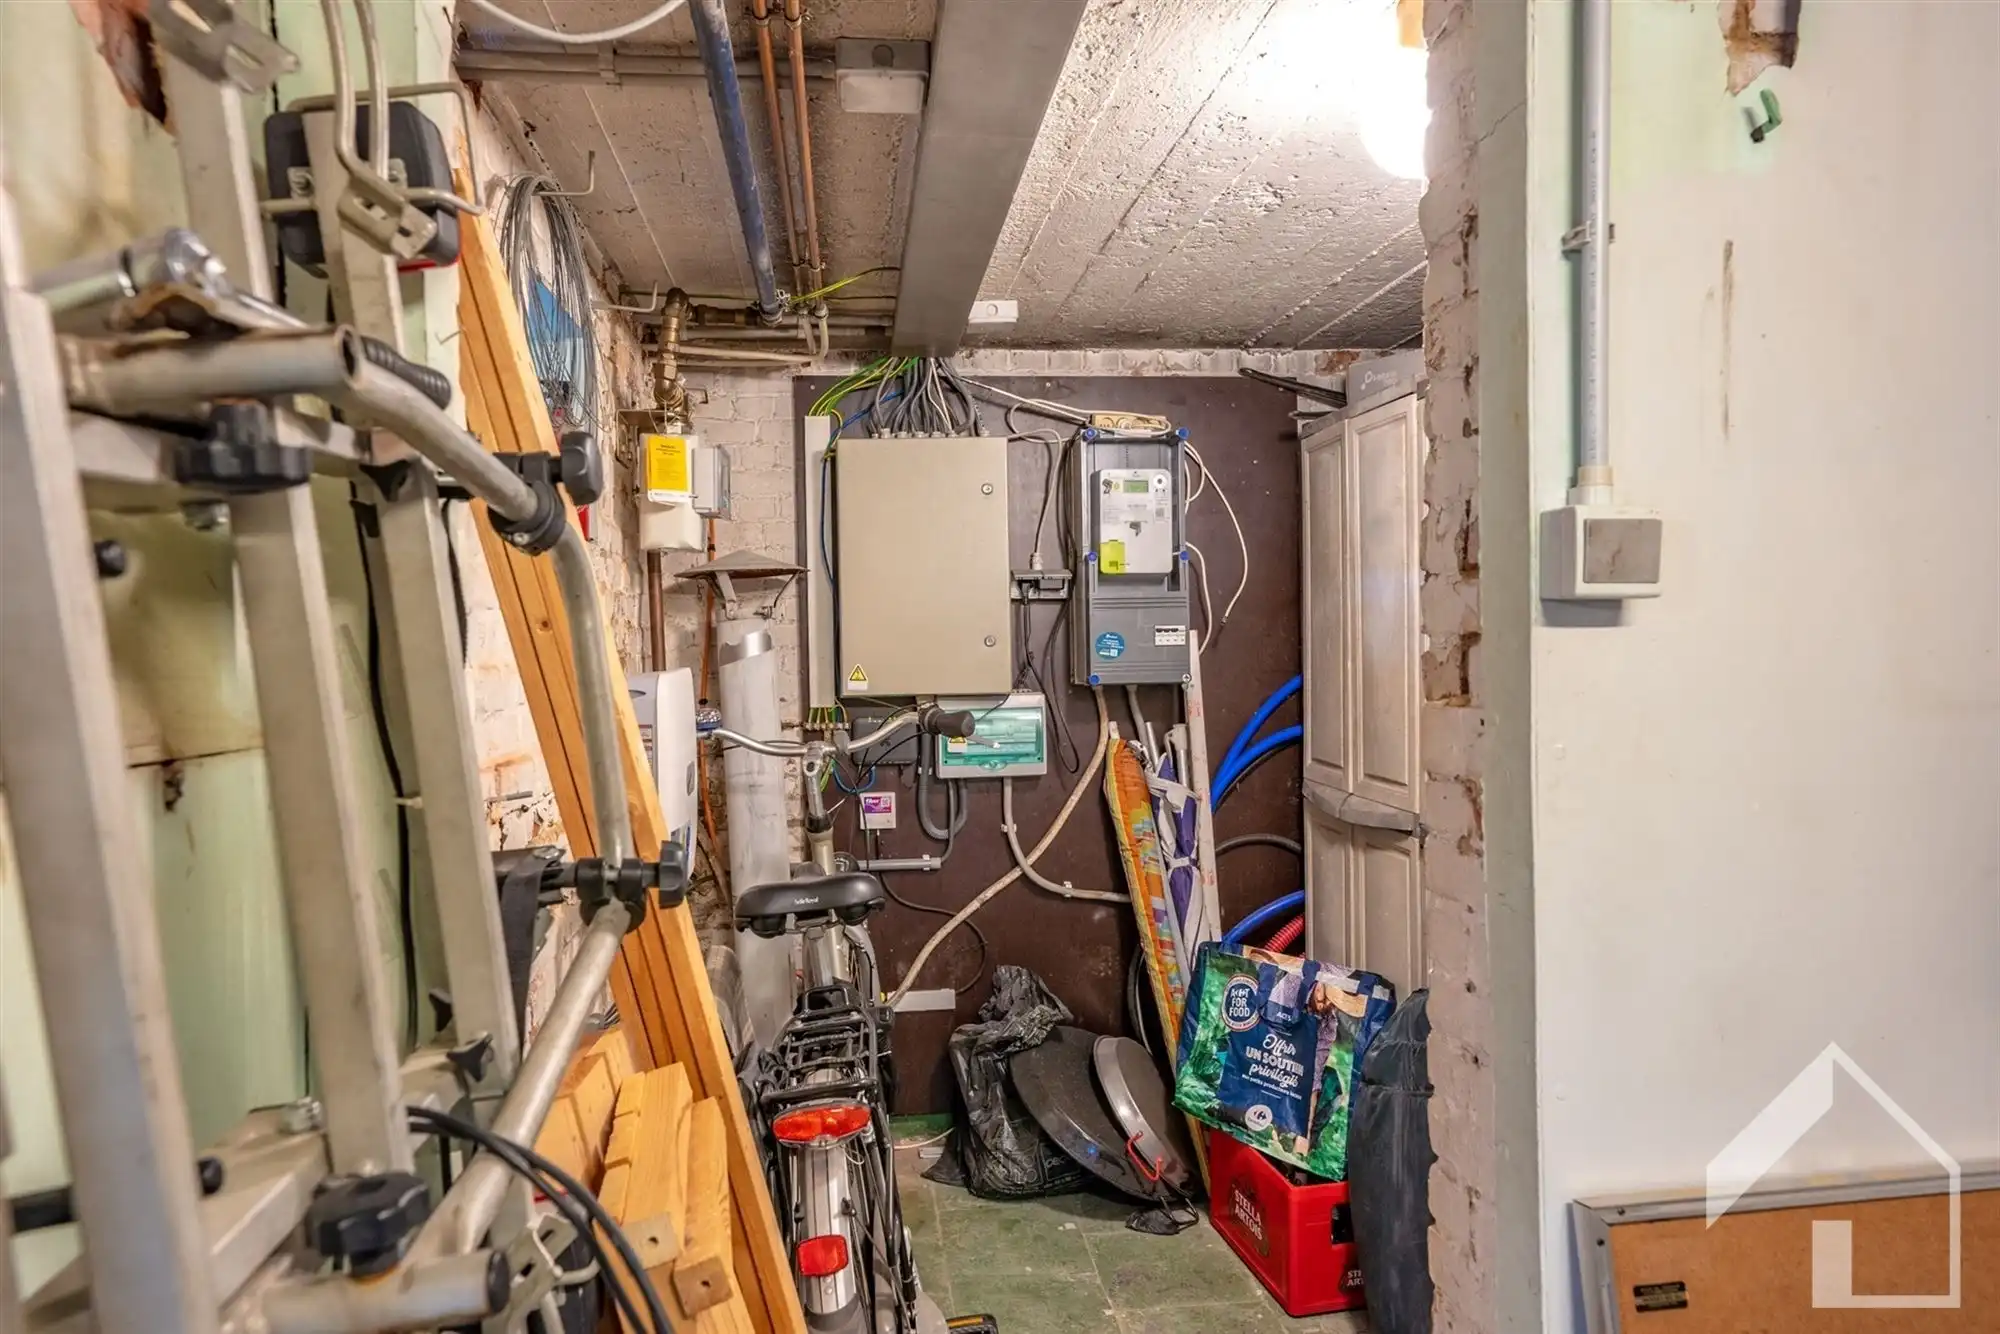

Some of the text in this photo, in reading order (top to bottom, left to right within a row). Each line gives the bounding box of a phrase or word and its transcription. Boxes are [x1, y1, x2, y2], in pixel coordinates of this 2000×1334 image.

[1231, 997, 1248, 1008] FOR
[1229, 1007, 1250, 1018] FOOD
[1245, 1045, 1262, 1061] UN
[1262, 1033, 1297, 1056] Offrir
[1233, 1189, 1262, 1227] STELLA
[1233, 1202, 1264, 1242] ARTOIS
